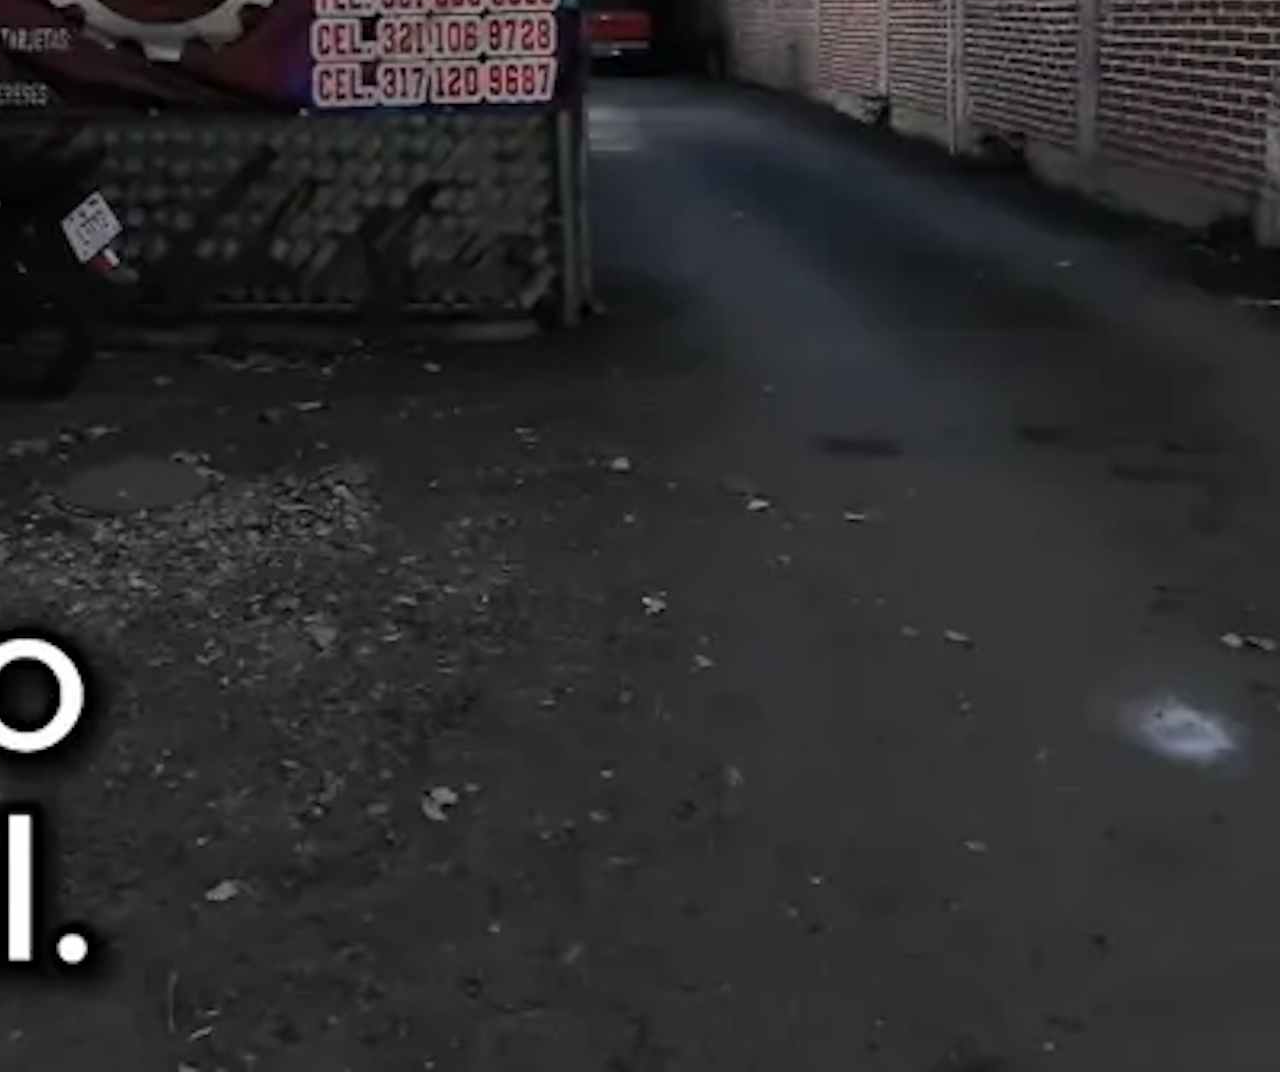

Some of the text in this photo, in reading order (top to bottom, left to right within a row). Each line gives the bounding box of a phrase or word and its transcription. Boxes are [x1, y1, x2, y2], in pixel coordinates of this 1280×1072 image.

[317, 17, 552, 56] CEL. 321 106 9728
[318, 62, 552, 101] CEL. 317 120 9687
